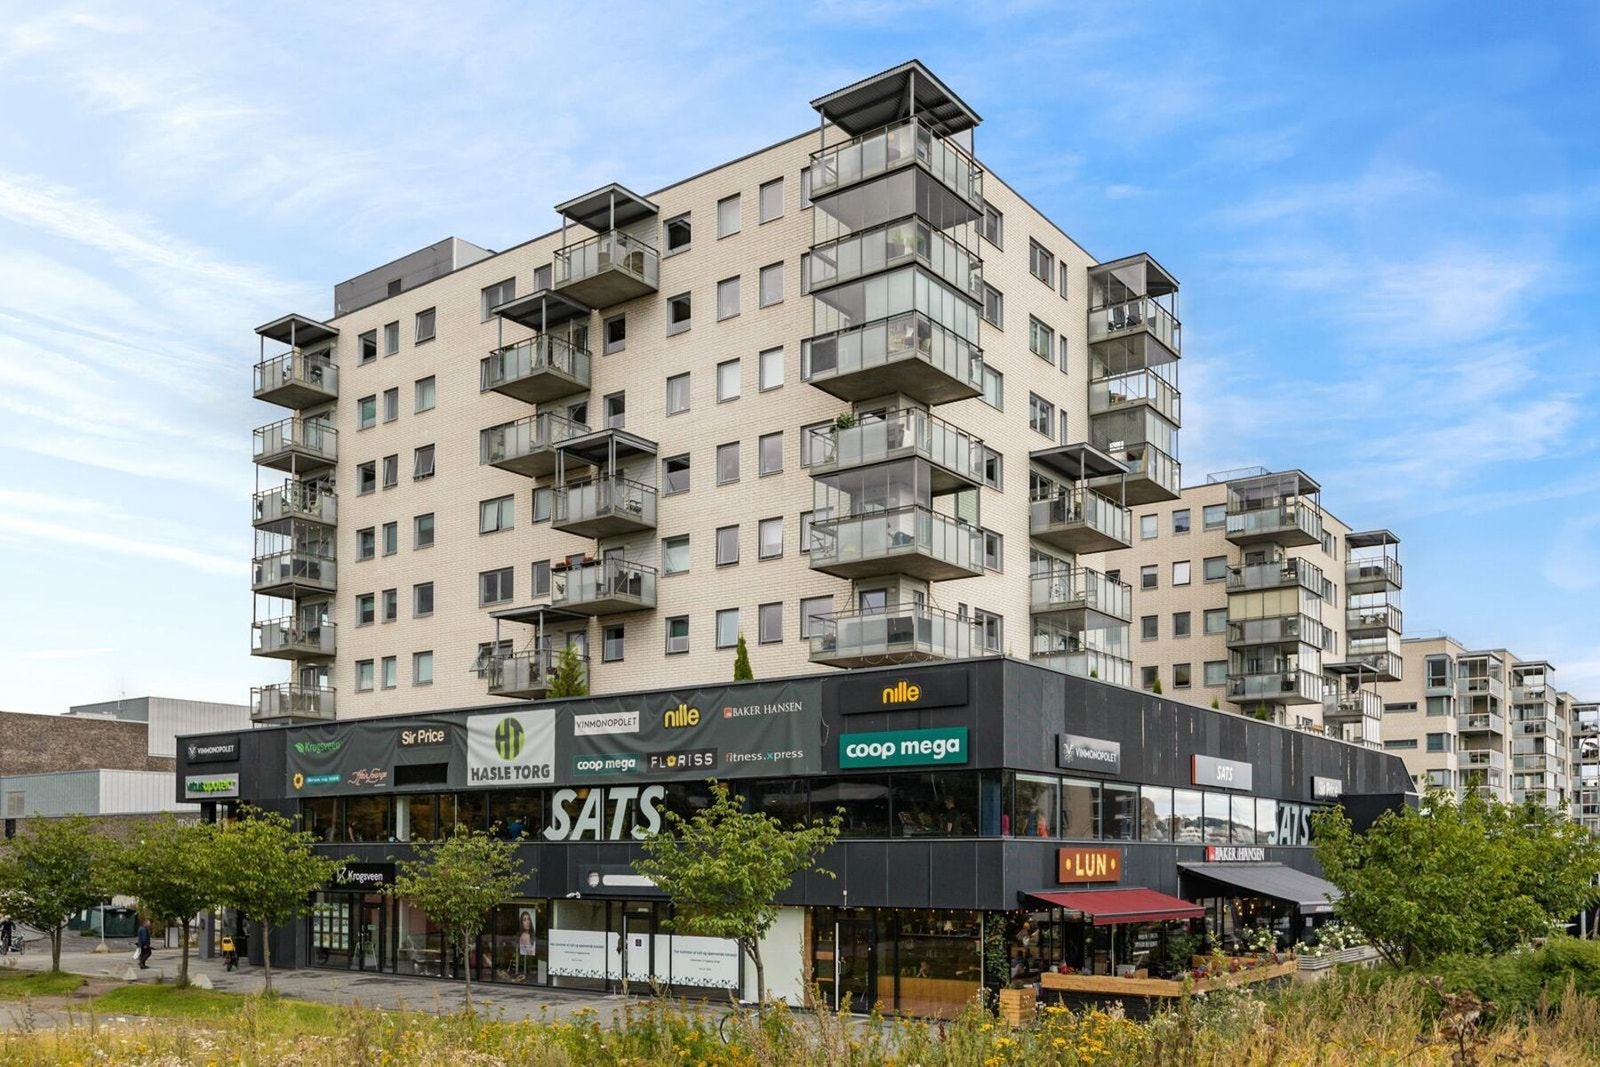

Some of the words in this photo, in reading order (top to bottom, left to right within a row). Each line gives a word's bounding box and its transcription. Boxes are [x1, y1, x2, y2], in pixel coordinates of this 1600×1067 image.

[882, 680, 921, 704] nille
[663, 704, 700, 729] nille
[733, 706, 761, 717] BAKER
[764, 702, 802, 715] HANSEN
[576, 717, 637, 729] VINMONOPOLET
[402, 731, 416, 744] Sir
[418, 729, 445, 743] Price
[846, 742, 895, 759] coop
[901, 738, 960, 759] mega
[1075, 748, 1118, 763] VINMONOPOLET
[471, 766, 512, 781] HASLE
[513, 764, 550, 779] TORG
[577, 759, 603, 771] coop
[605, 757, 636, 770] mega
[1216, 765, 1233, 782] SATS
[543, 785, 665, 840] SATS
[1267, 803, 1312, 846] SATS
[1237, 847, 1265, 861] HANSEN
[1075, 853, 1107, 877] LUN
[347, 870, 383, 883] Krogsveen
